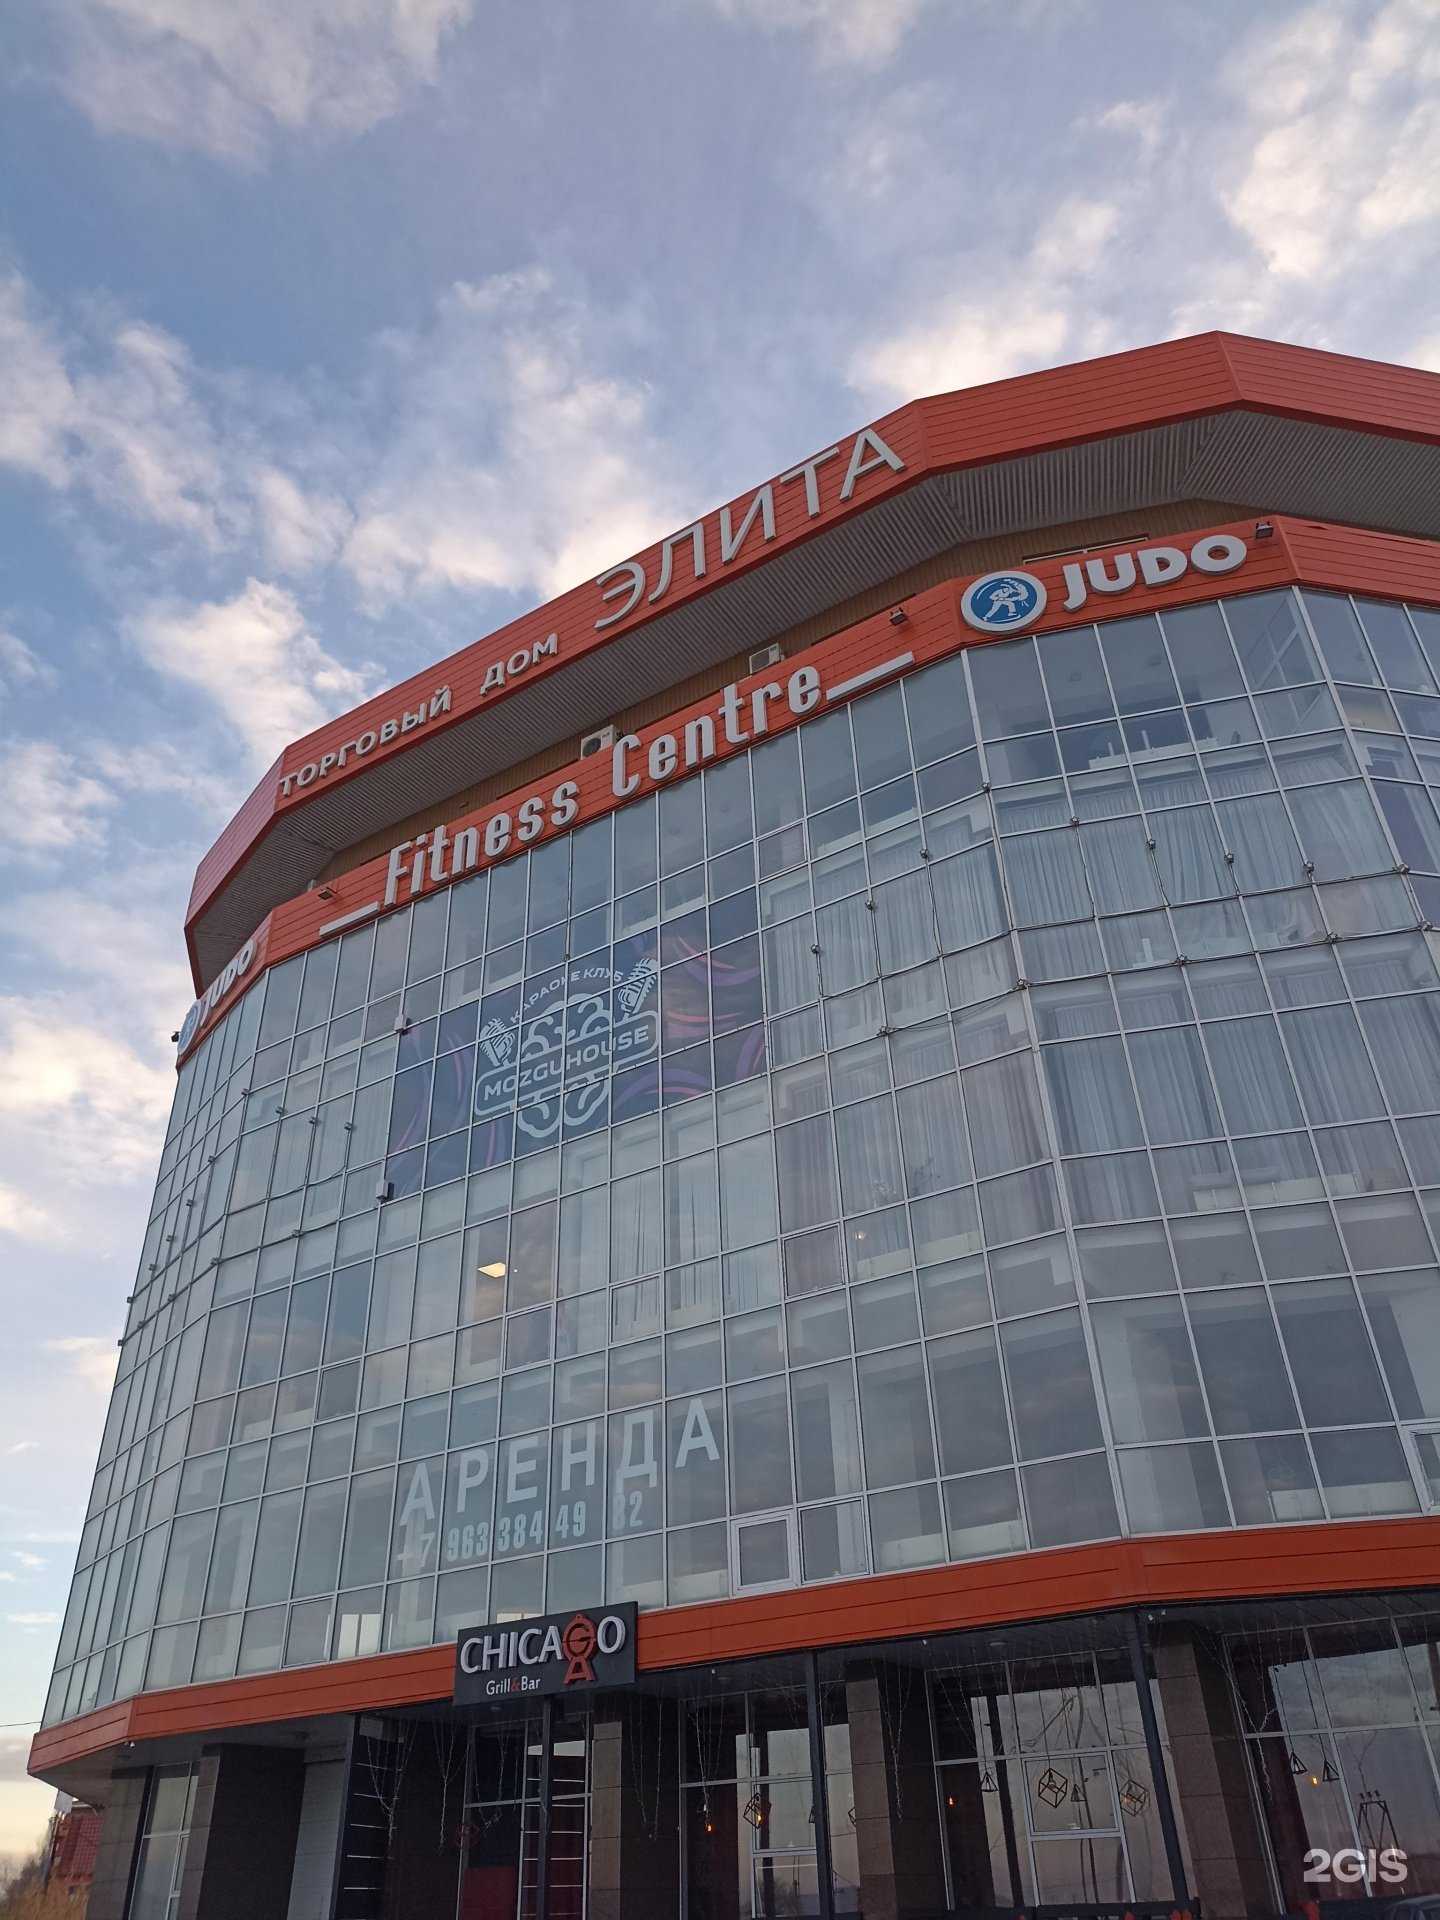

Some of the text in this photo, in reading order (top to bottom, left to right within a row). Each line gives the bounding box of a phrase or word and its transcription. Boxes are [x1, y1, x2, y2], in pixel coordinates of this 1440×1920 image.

[279, 428, 905, 797] ТОРГОВЫЙ ДОМ ЭЛИТА
[1062, 534, 1247, 613] JUDO
[382, 665, 821, 908] Fitness Centre
[483, 1024, 649, 1100] MOZGUHOUSE
[399, 1399, 720, 1526] АРЕНДА
[447, 1522, 489, 1562] 963
[497, 1511, 543, 1552] 384
[555, 1501, 586, 1539] 49
